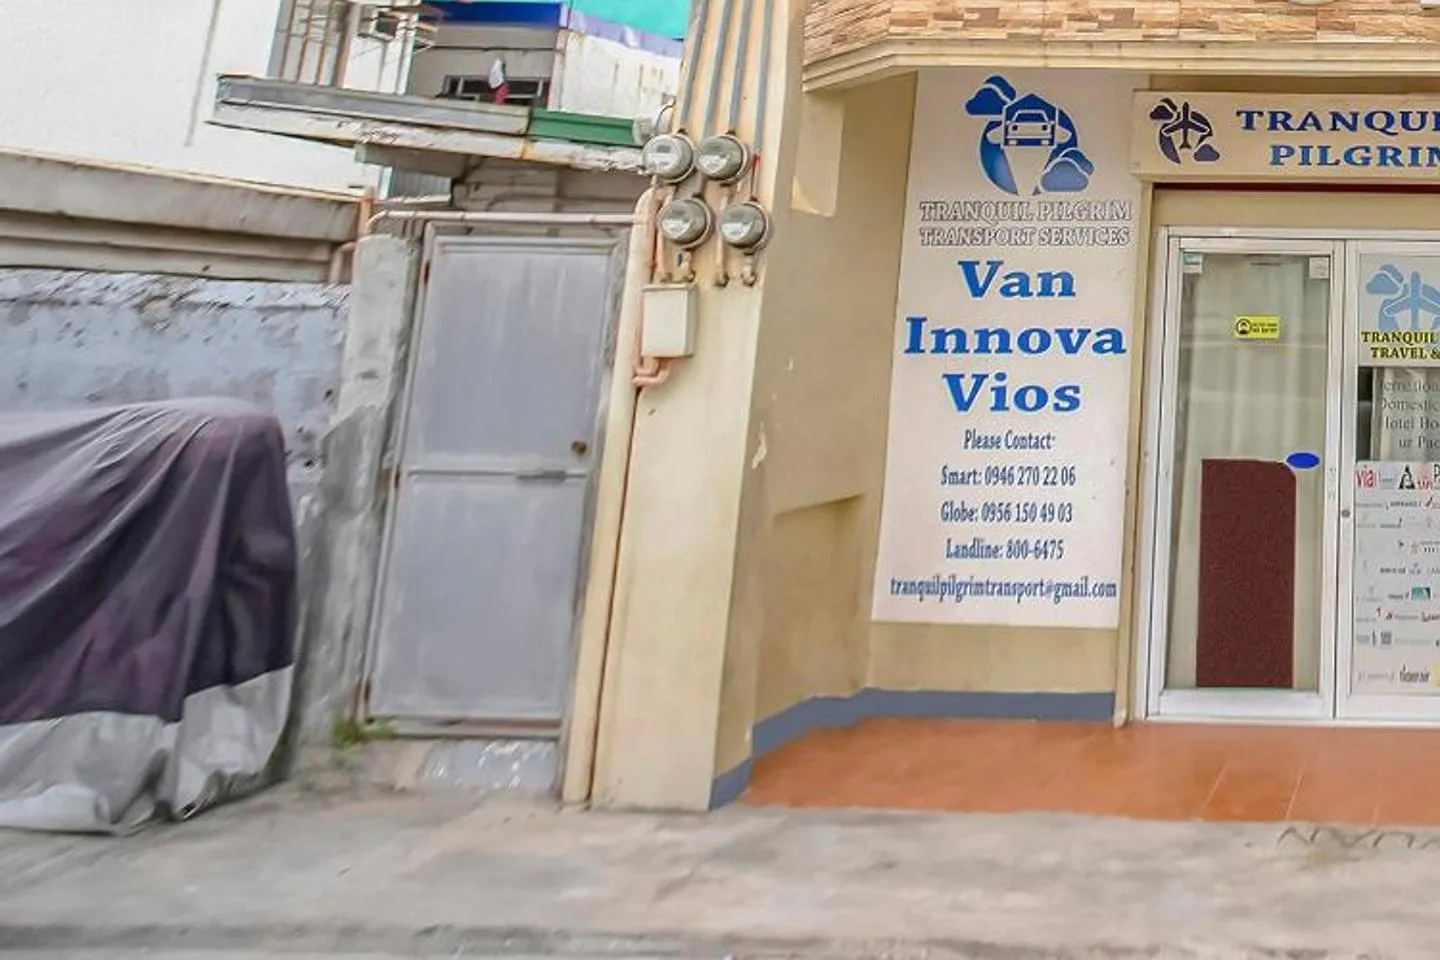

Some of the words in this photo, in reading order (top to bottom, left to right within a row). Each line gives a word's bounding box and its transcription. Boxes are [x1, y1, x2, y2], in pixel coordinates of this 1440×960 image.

[919, 200, 1034, 227] TRANQUIL
[1036, 200, 1133, 222] PILGRIM
[919, 226, 1037, 247] TRANSPORT
[1038, 226, 1131, 246] SERVICES
[957, 259, 1077, 299] Van
[903, 316, 1127, 355] Innova
[1361, 330, 1437, 346] TRANQUIL
[1370, 346, 1428, 360] TRAVEL
[941, 371, 1082, 413] Vios
[962, 428, 1002, 451] Please
[1004, 430, 1057, 451] Contact:
[940, 465, 983, 487] Smart:
[984, 466, 1015, 487] 0946
[1016, 466, 1041, 487] 270
[1042, 466, 1060, 487] 22
[1060, 466, 1077, 487] 06
[940, 501, 979, 523] Globe:
[1014, 502, 1038, 523] 150
[1039, 502, 1056, 523] 49
[1057, 502, 1074, 523] 03
[945, 538, 1004, 559] Landline:
[1005, 539, 1065, 560] 800-6475
